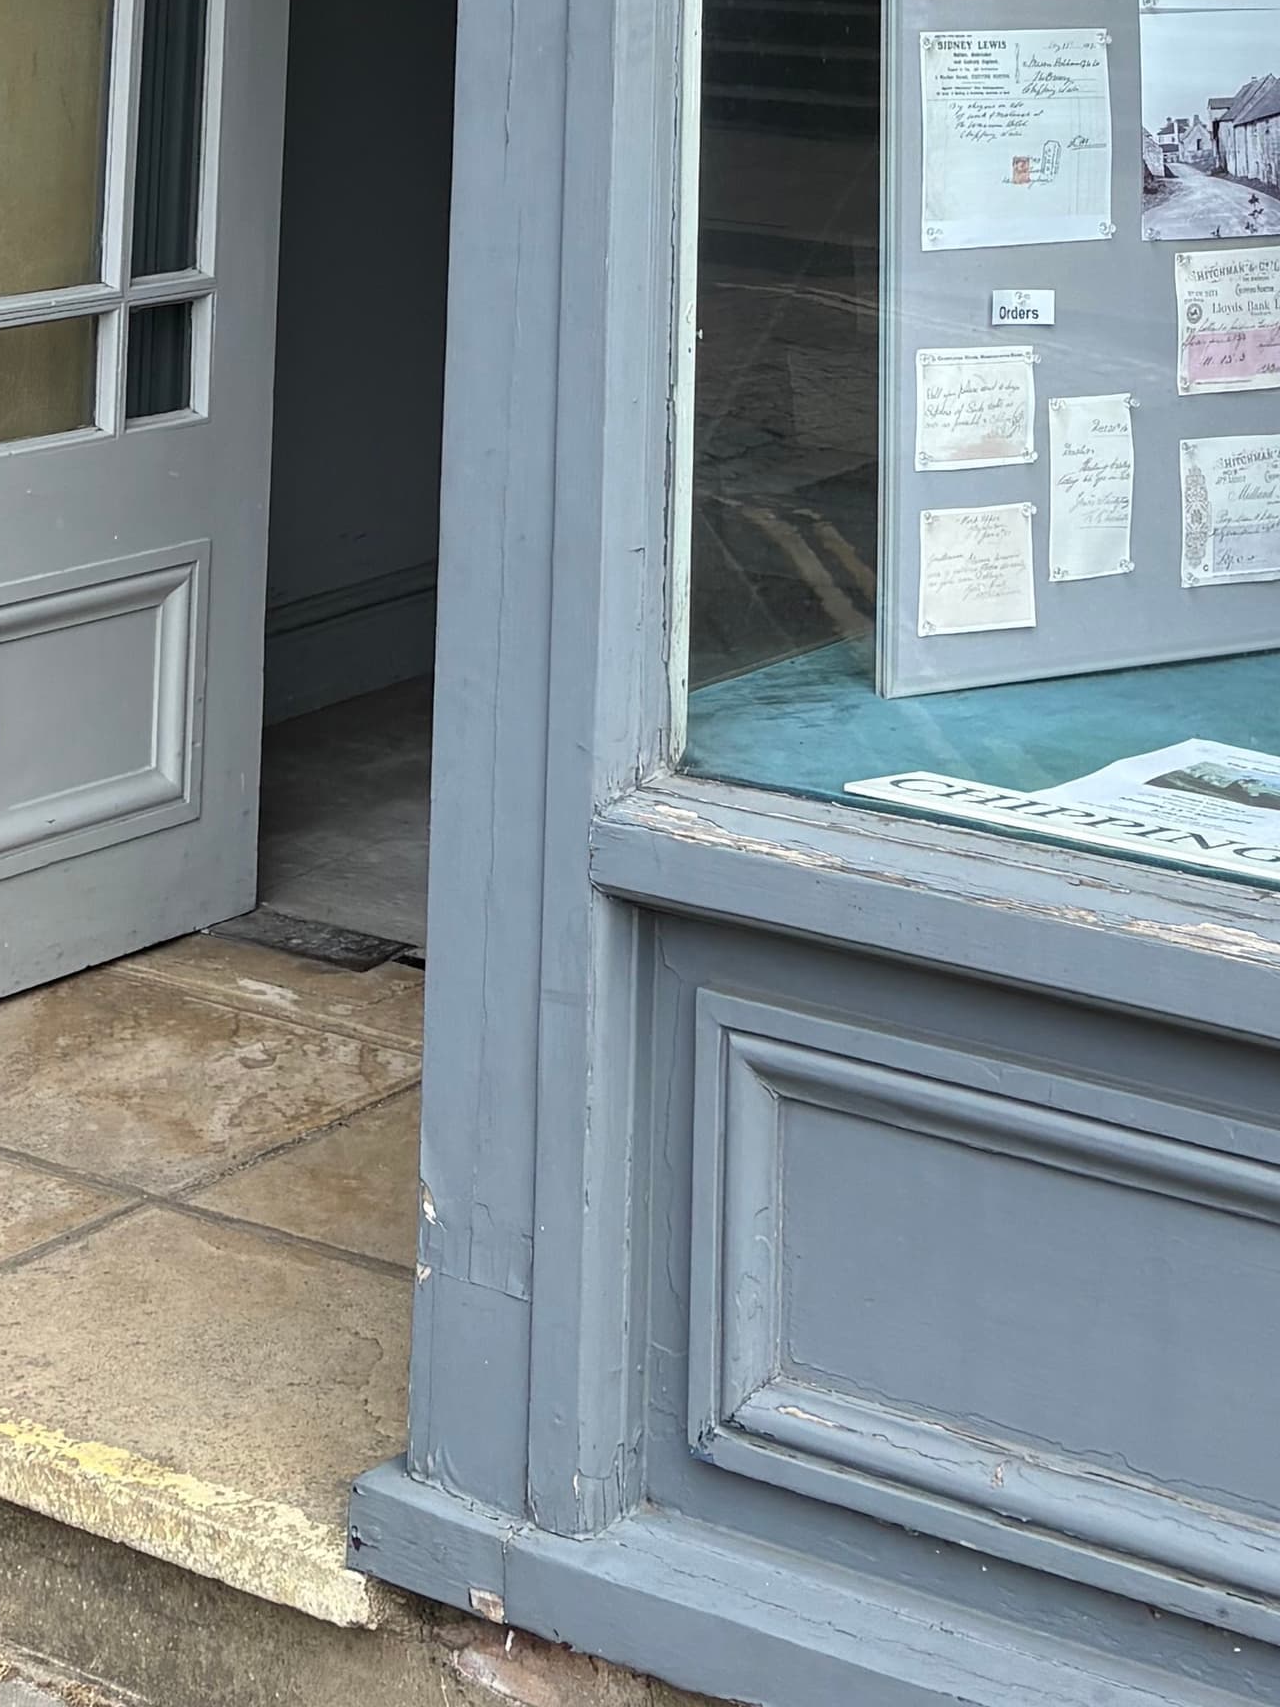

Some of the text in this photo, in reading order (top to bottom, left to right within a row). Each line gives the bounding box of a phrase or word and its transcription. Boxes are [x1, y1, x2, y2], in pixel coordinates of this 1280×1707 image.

[935, 40, 1006, 49] SIDNEY LEWIS
[999, 306, 1039, 319] Orders
[1212, 302, 1243, 315] Lloyds
[1247, 300, 1271, 314] Bank
